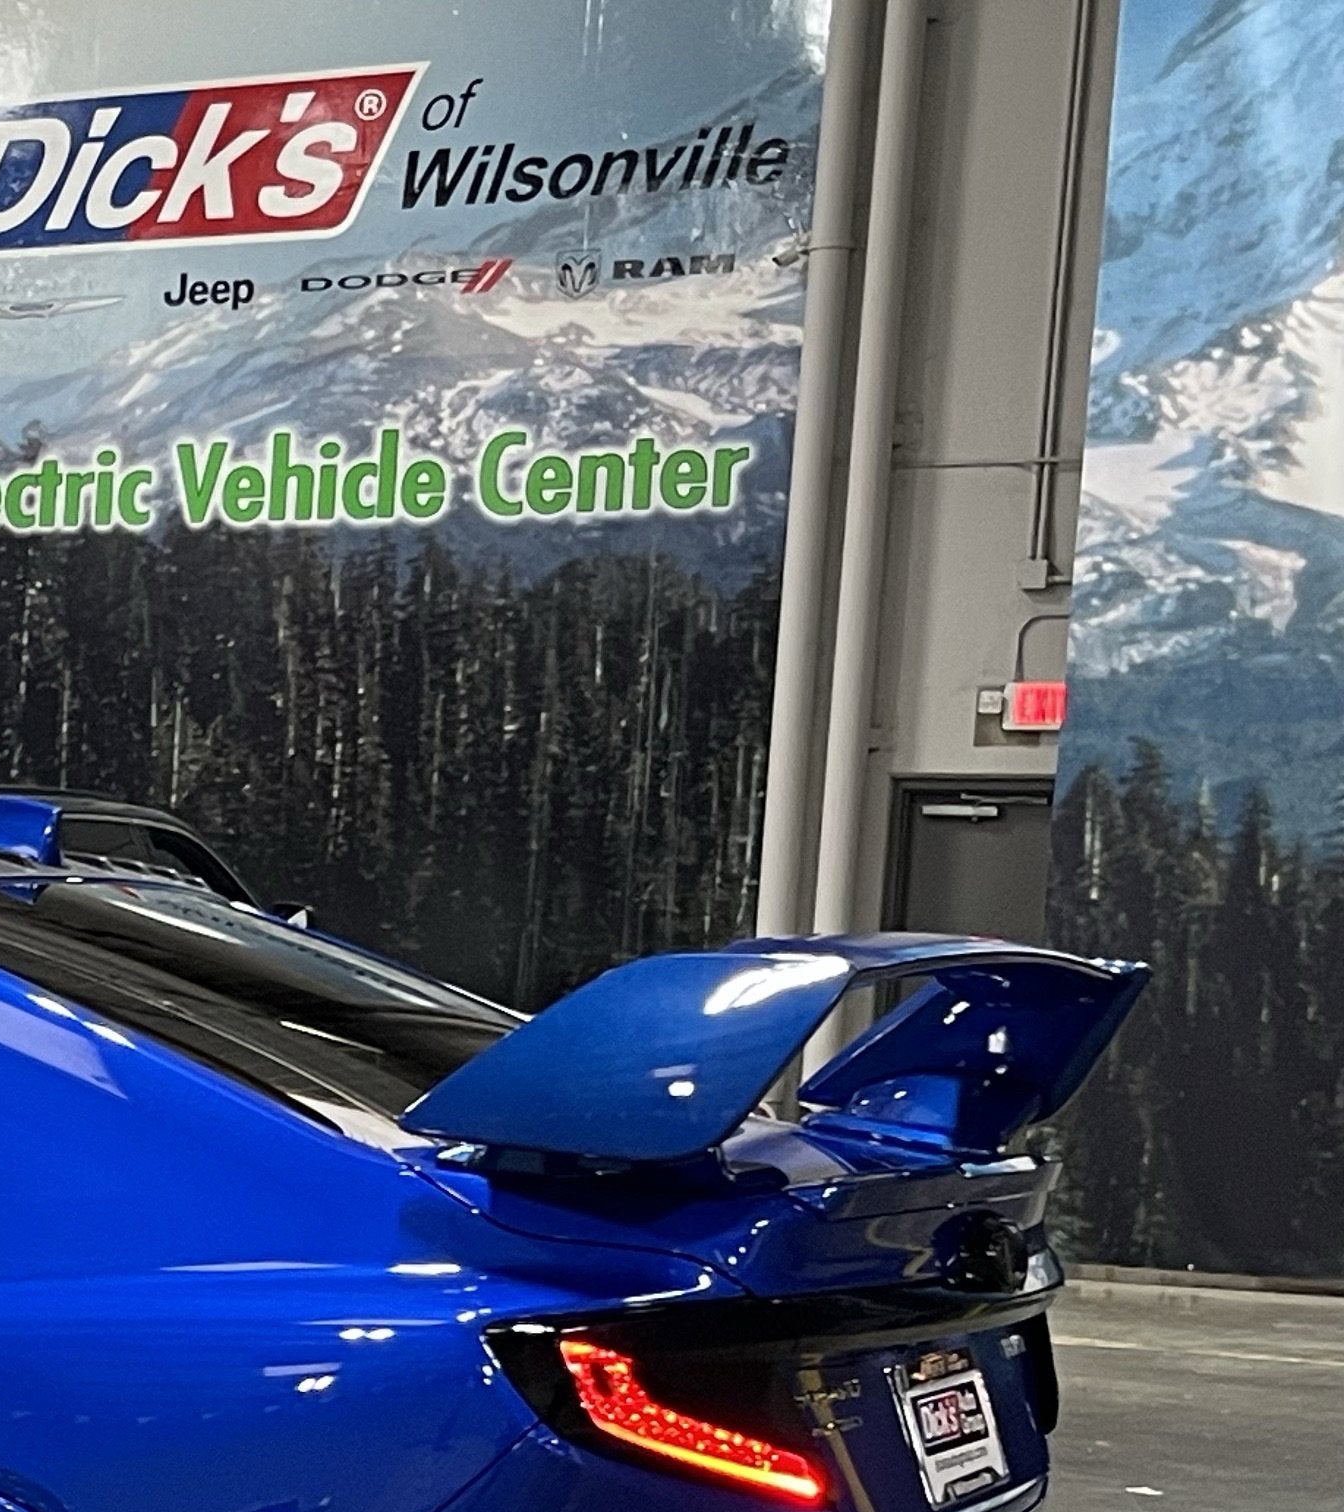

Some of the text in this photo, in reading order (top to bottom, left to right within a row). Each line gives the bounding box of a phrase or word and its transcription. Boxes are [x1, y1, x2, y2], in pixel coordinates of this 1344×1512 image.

[421, 77, 484, 131] of
[401, 122, 791, 210] Wilsonville
[301, 267, 482, 292] DODGE
[612, 254, 736, 280] RAM
[163, 272, 255, 310] Jeep
[176, 429, 446, 524] Vehicle
[478, 431, 750, 516] Center
